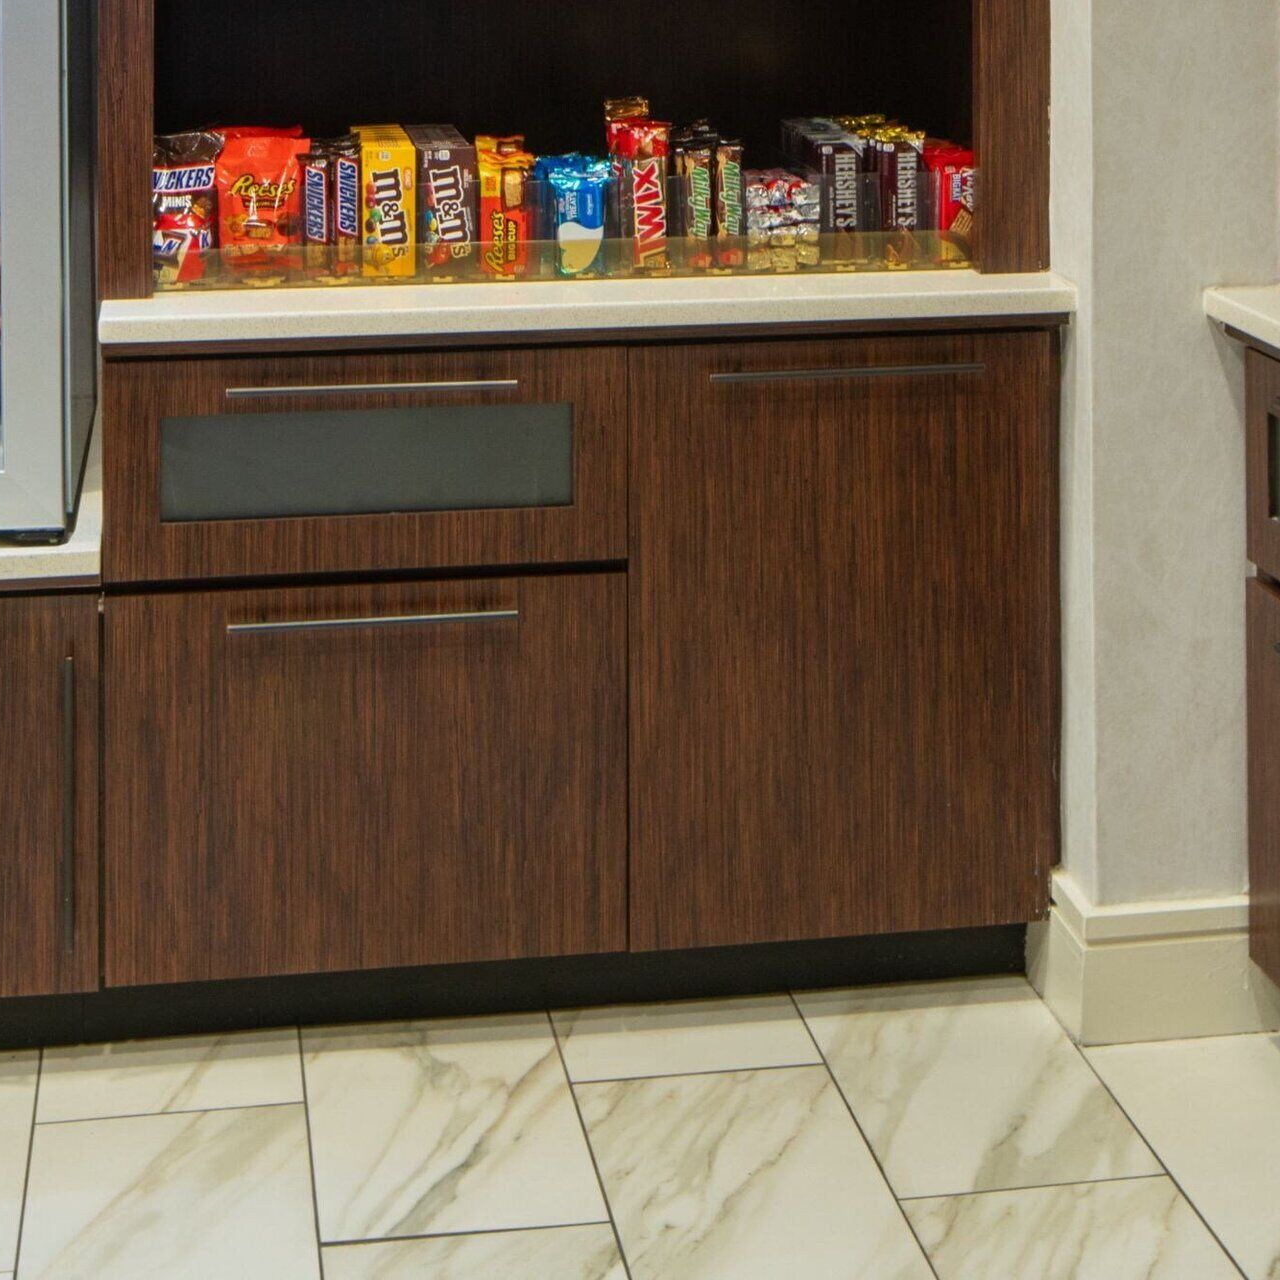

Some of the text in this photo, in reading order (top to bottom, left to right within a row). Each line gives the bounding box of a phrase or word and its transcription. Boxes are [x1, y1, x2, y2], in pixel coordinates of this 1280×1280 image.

[154, 166, 214, 191] NICKERS
[161, 195, 192, 207] MINIS
[231, 174, 297, 197] Reese's
[306, 169, 325, 243] SNICKERS
[339, 160, 357, 234] SNICKERS
[632, 162, 667, 257] TWIX
[719, 160, 741, 205] Milky
[835, 153, 857, 228] HERSHEY'S
[897, 151, 917, 226] HERSHEY'S
[484, 210, 504, 272] Reese's
